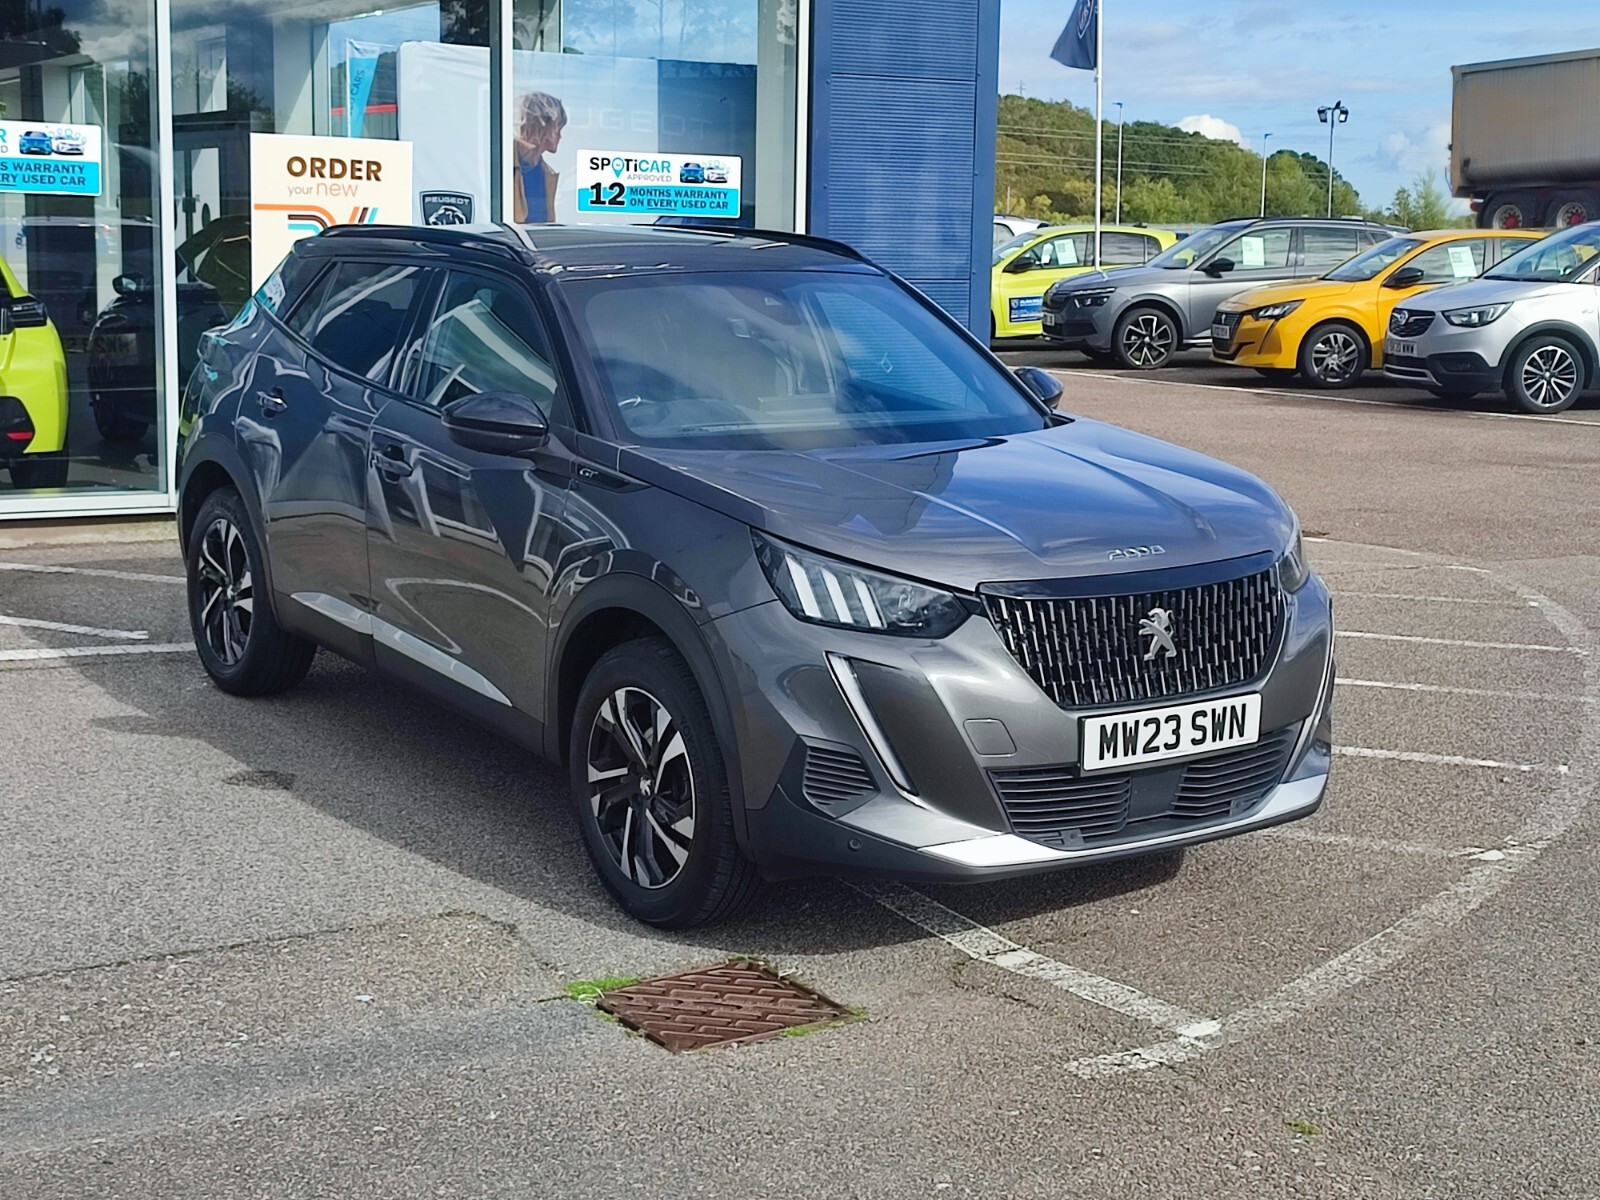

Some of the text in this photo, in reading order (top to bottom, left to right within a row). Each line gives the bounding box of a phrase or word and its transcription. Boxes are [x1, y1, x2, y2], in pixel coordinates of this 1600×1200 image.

[12, 162, 85, 174] WARRANTY
[286, 156, 382, 182] ORDER
[22, 174, 57, 185] USED
[60, 175, 86, 186] CAR
[626, 174, 672, 183] APPROVED
[287, 182, 358, 197] your new
[589, 182, 625, 206] 12
[630, 187, 728, 200] MONTHS WARRANTY
[424, 196, 470, 205] PEUGEOT
[630, 198, 728, 209] ON EVERY USED CAR
[579, 468, 599, 479] GT
[1098, 703, 1247, 761] MW23 SWN
